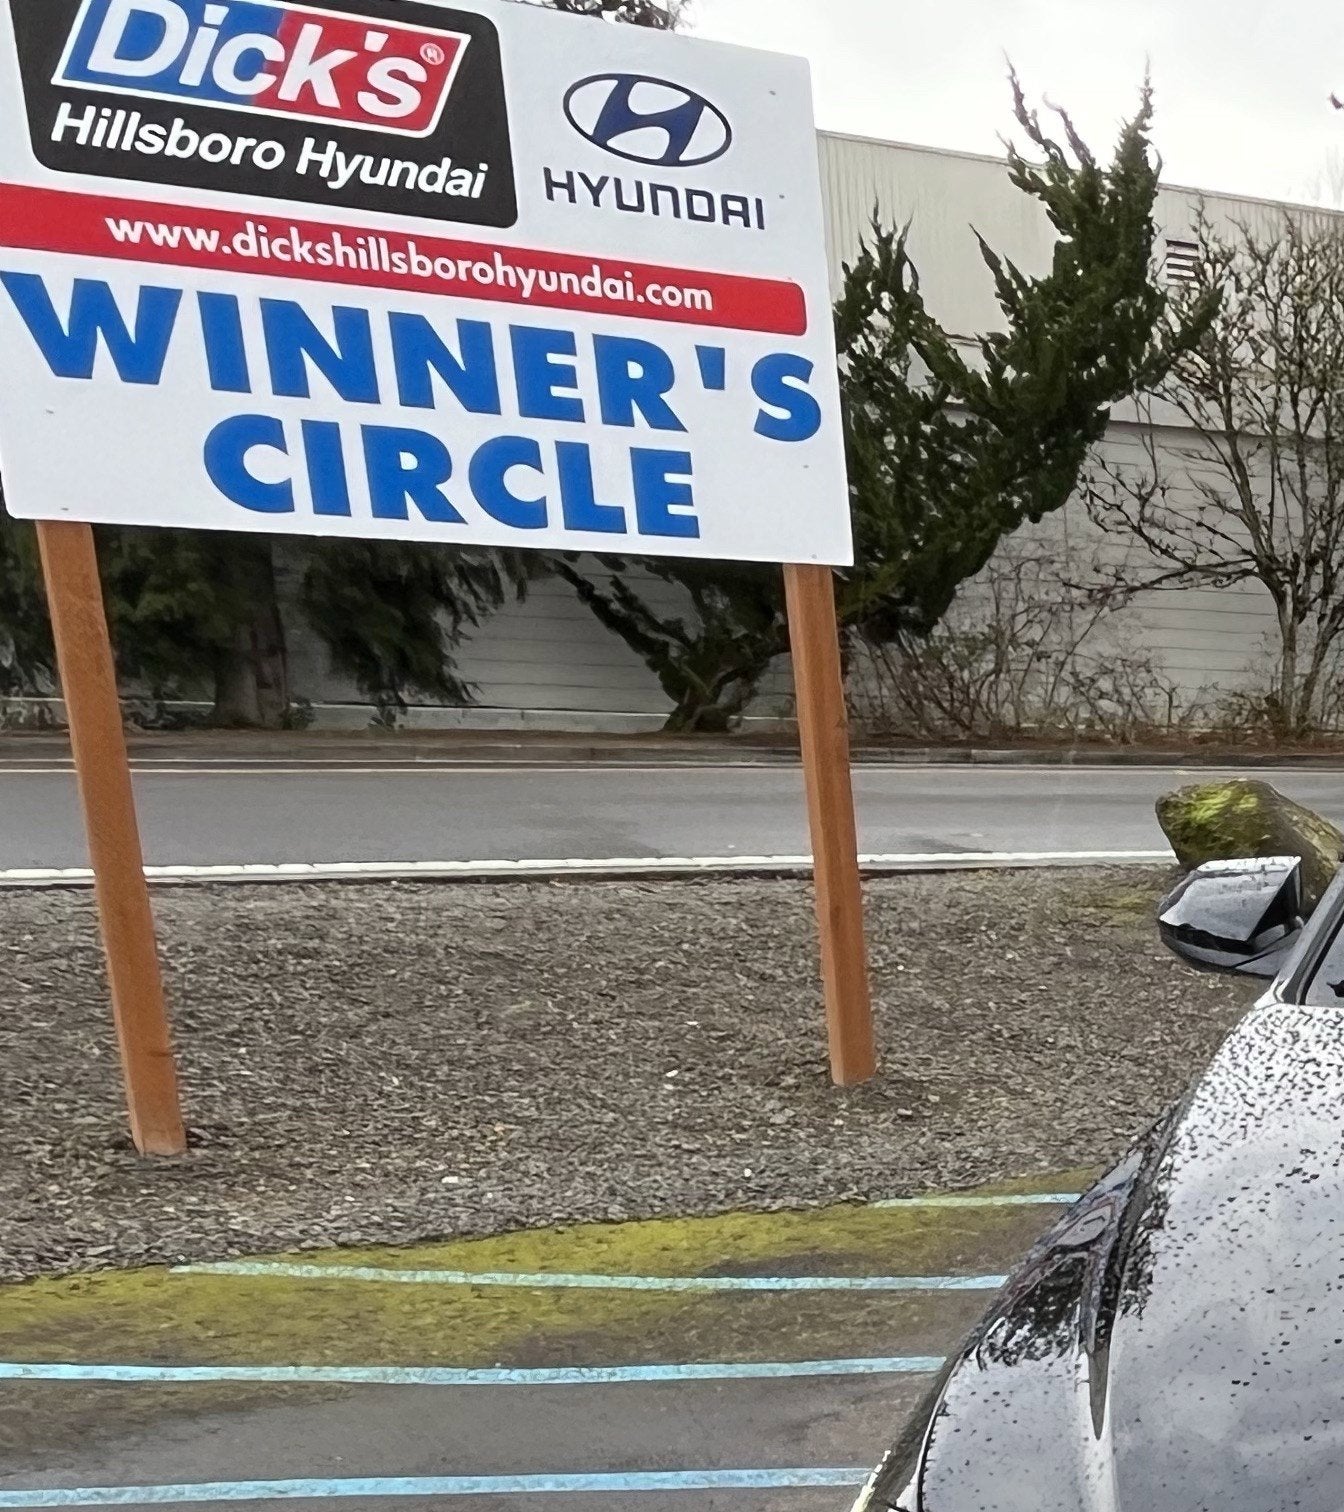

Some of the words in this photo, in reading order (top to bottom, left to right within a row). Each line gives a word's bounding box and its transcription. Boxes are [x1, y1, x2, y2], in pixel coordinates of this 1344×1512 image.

[87, 0, 428, 119] Dick's
[51, 103, 286, 170] Hillsboro
[296, 137, 489, 198] Hyundai
[544, 167, 766, 231] HYUNDAI
[105, 216, 713, 312] www.dickshillsborohyundai.com
[0, 270, 822, 443] WINNER'S
[203, 413, 701, 540] CIRCLE
